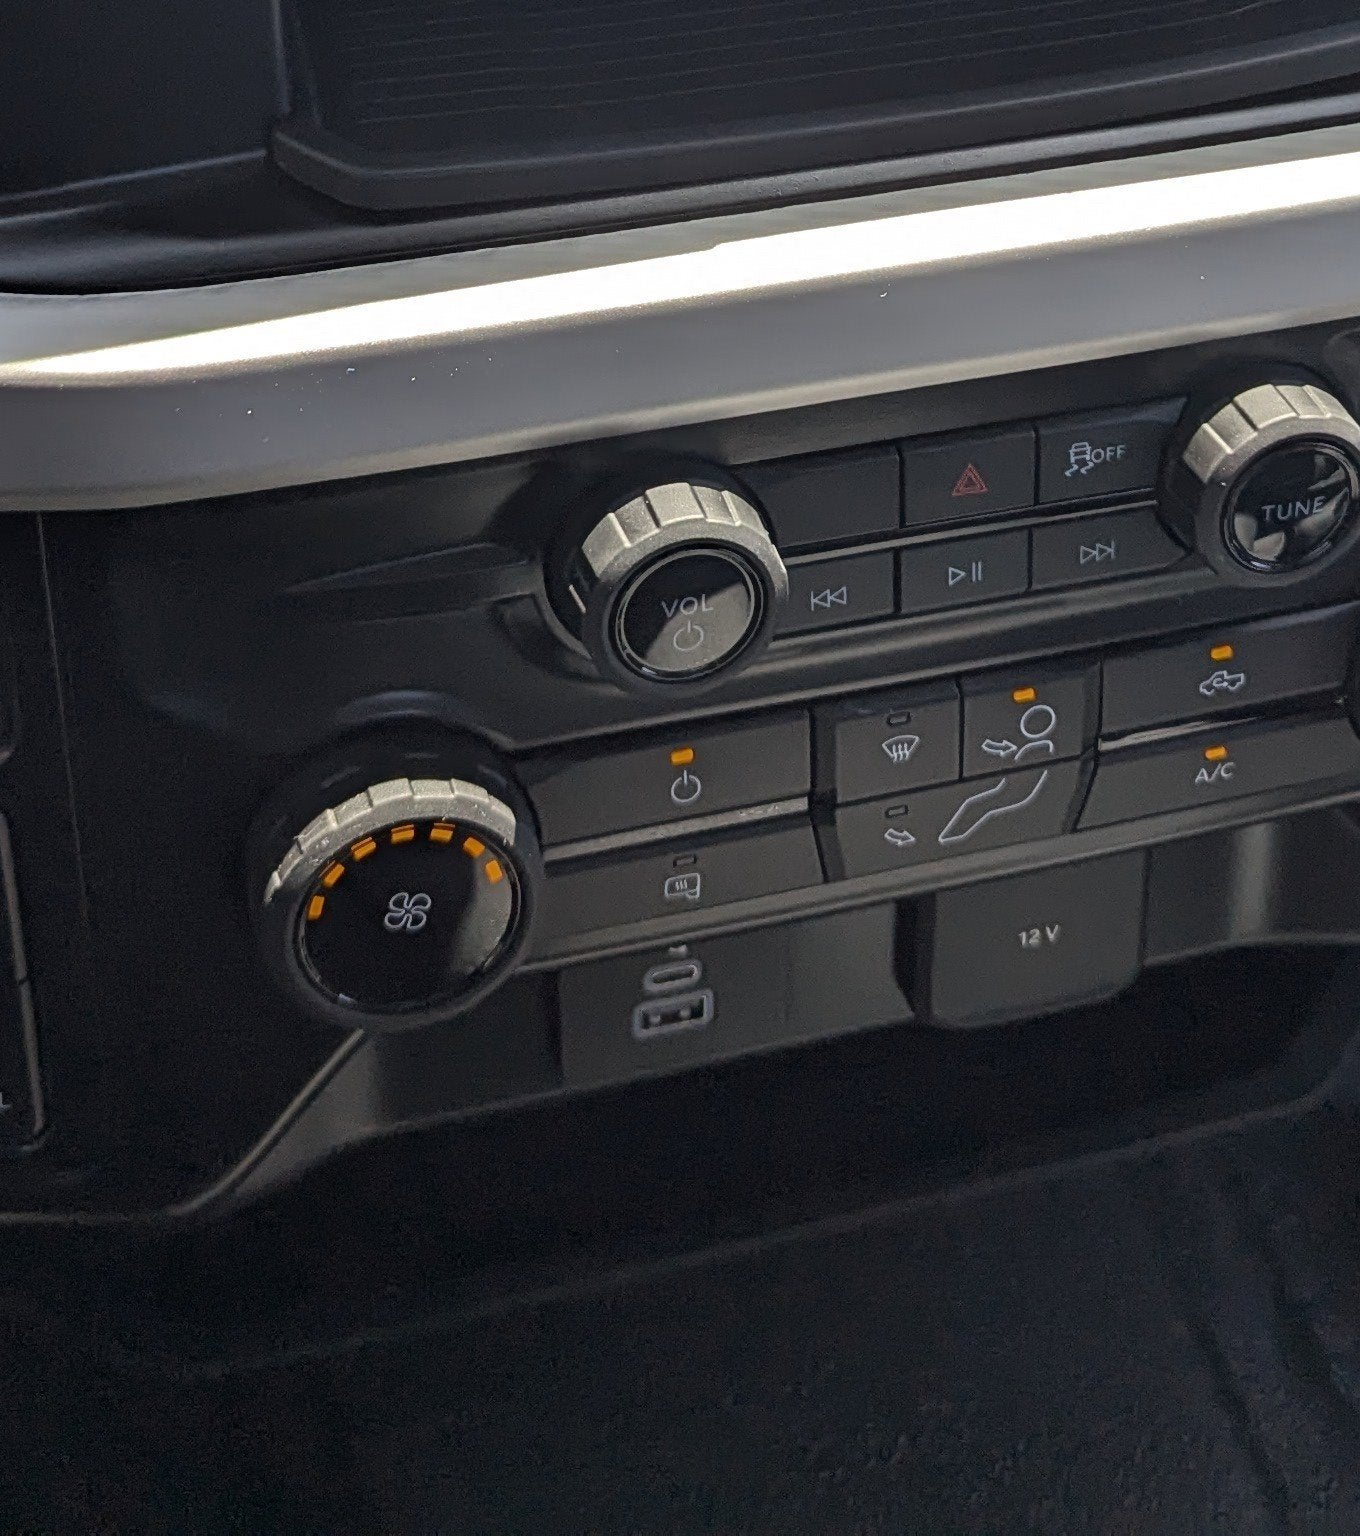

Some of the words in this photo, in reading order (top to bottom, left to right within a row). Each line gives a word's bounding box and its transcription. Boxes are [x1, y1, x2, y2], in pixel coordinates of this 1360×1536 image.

[1090, 444, 1127, 465] OFF
[1261, 495, 1327, 522] TUNE
[660, 593, 714, 618] VOL
[1194, 762, 1237, 785] A/C
